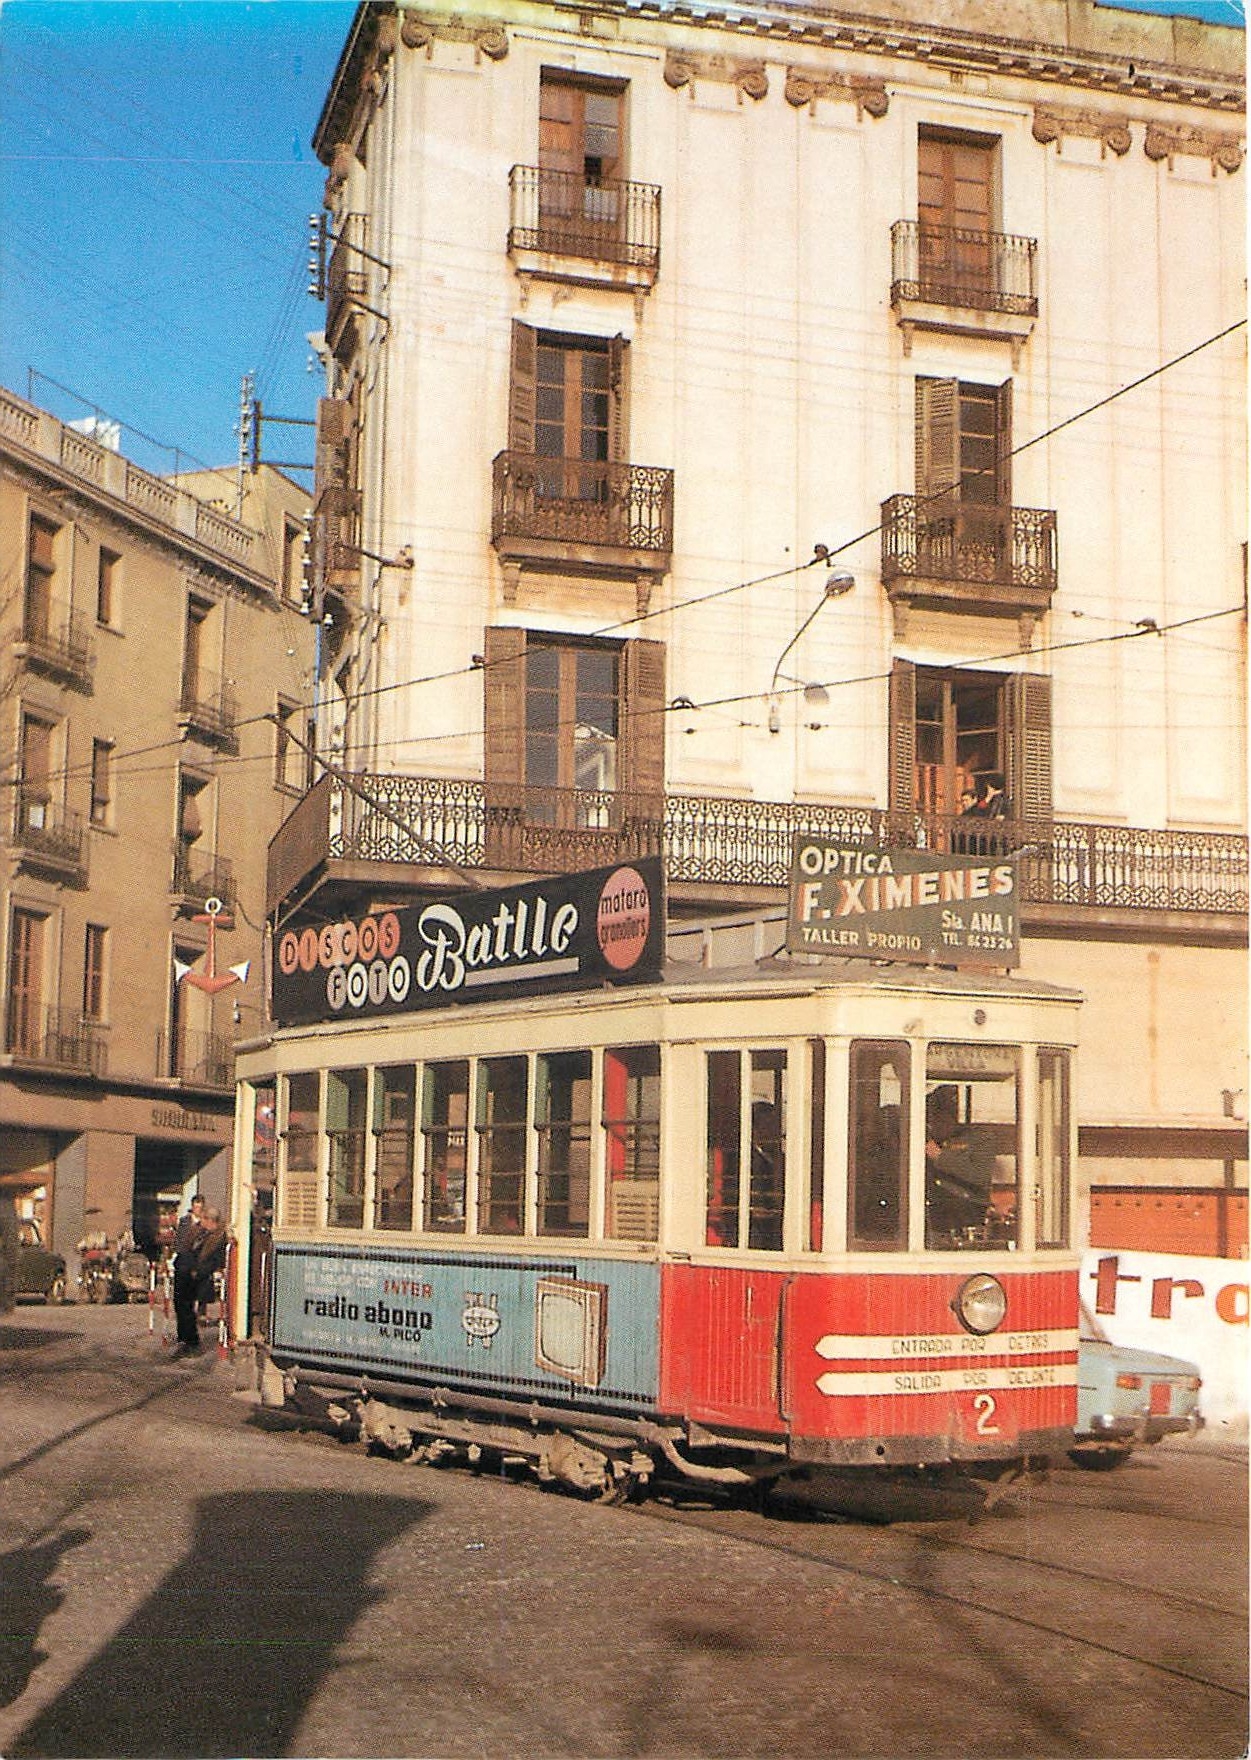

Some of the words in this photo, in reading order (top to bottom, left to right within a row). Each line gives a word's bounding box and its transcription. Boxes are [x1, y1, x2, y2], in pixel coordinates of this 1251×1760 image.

[799, 846, 893, 875] OPTICA
[797, 882, 832, 923] F.
[835, 865, 1014, 917] XIMENES
[802, 928, 859, 946] TALLER
[867, 932, 922, 951] PROPIO
[970, 912, 1004, 934] ANA
[282, 917, 397, 970] DISCOS
[416, 897, 578, 991] Batlle
[330, 962, 407, 1005] FOTO
[383, 1279, 433, 1298] INTER
[303, 1292, 359, 1320] radio
[364, 1300, 433, 1330] abono
[892, 1338, 952, 1356] ENTRADA
[961, 1336, 986, 1352] POR
[1008, 1333, 1048, 1350] DETRAS
[894, 1375, 942, 1391] SALIDA
[962, 1371, 987, 1386] POR
[1008, 1368, 1056, 1385] DELANTE
[973, 1393, 999, 1436] 2
